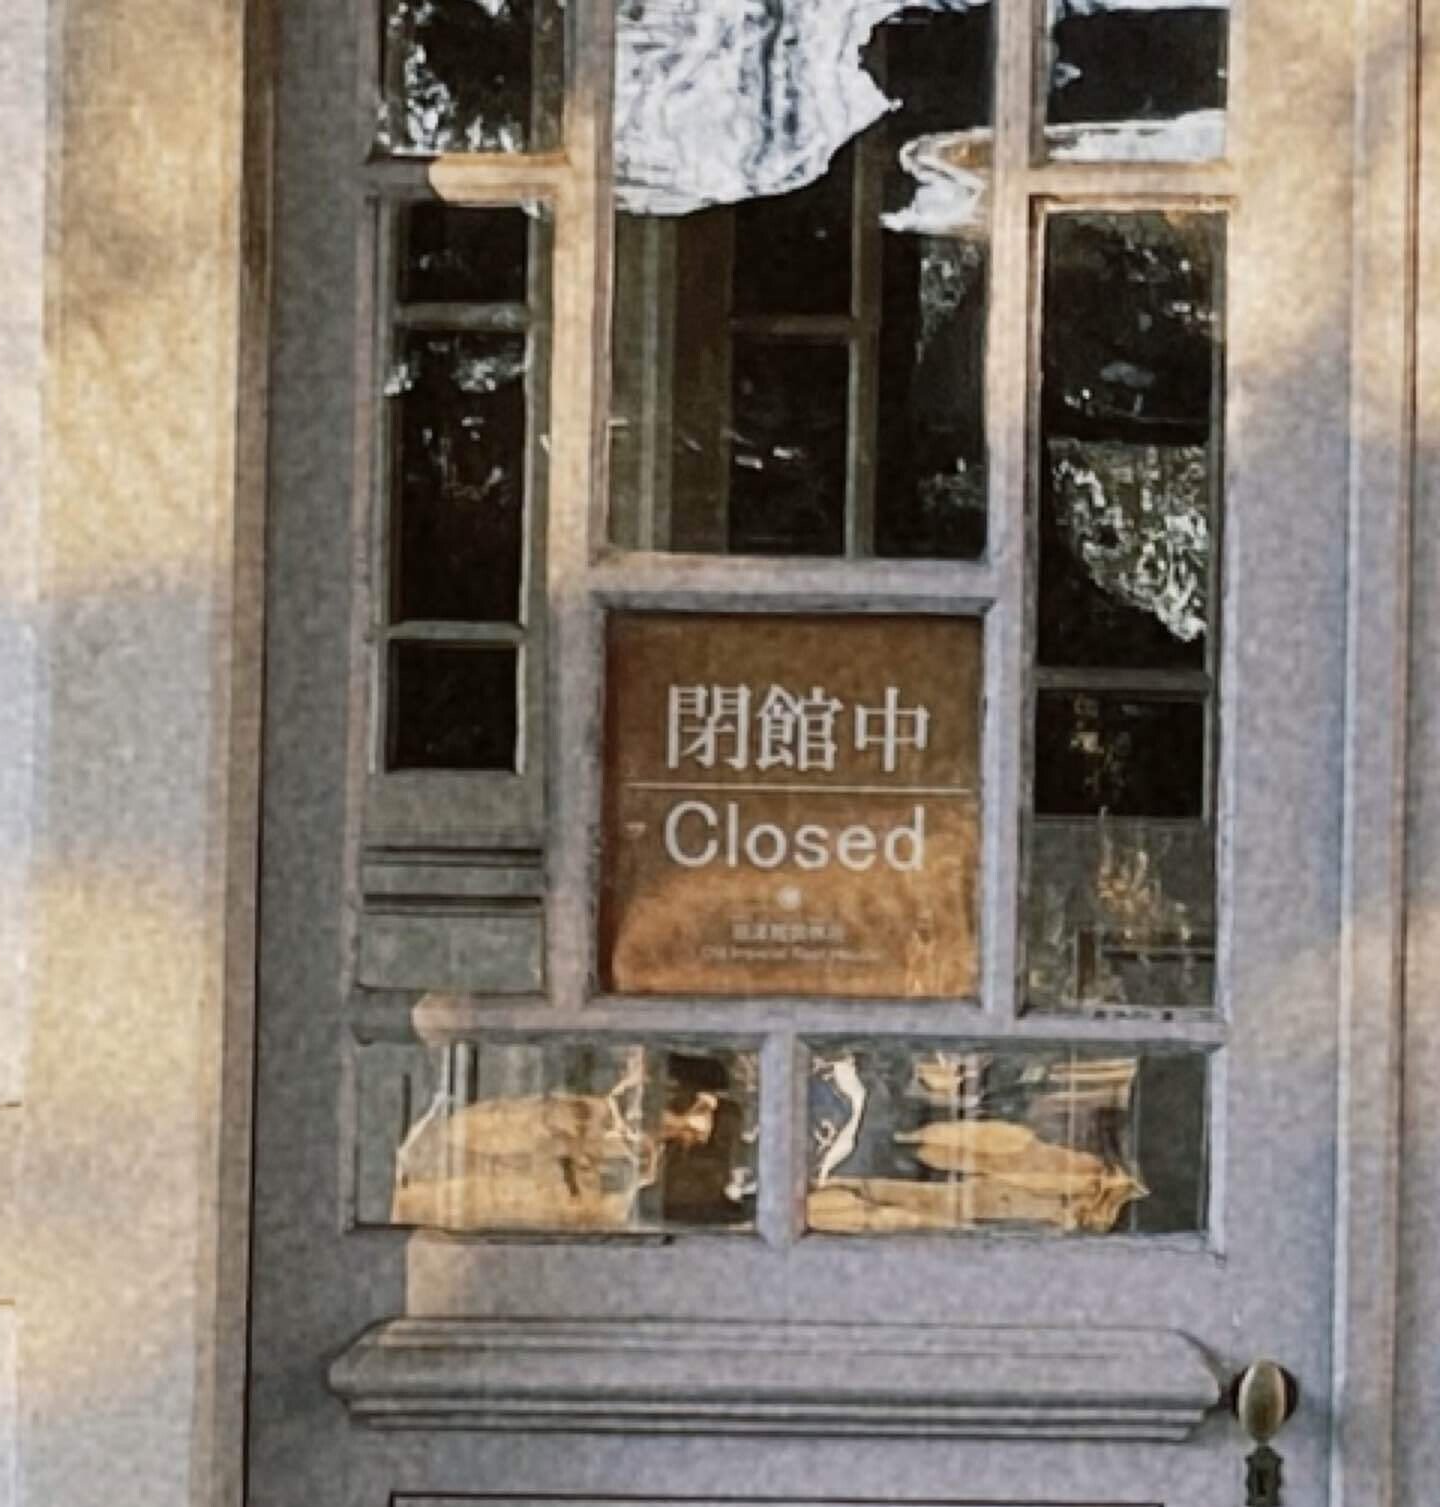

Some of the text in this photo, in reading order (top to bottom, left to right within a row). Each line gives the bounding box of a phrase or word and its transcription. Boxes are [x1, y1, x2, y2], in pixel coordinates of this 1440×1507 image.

[666, 684, 930, 772] 閉館中
[664, 800, 926, 872] Closed
